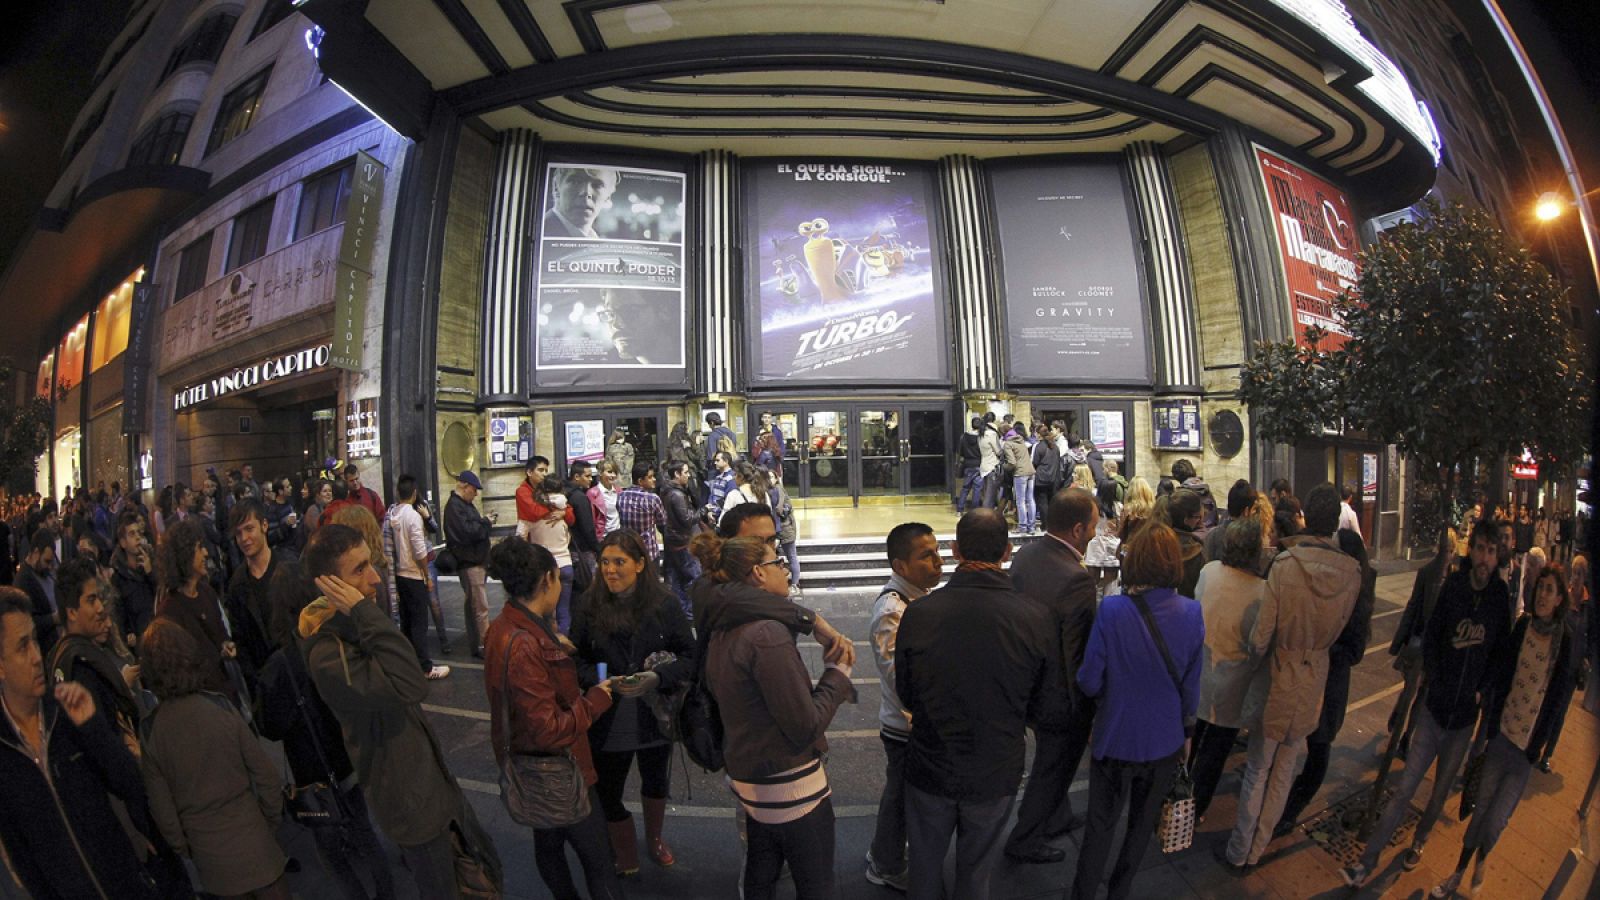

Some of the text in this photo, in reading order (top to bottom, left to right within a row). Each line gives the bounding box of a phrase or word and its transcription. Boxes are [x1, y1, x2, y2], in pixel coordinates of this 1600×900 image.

[777, 164, 793, 173] EL
[796, 164, 825, 174] QUE
[830, 164, 847, 173] LA
[794, 172, 891, 183] LA CONSIGUE.
[353, 194, 370, 259] VINCCI
[547, 260, 676, 276] EL QUINTO PODER
[346, 270, 357, 354] CAPITOL
[1035, 307, 1115, 317] GRAVITY
[795, 310, 913, 359] TURBO
[174, 343, 333, 410] HOTEL VINCCI CAPITO
